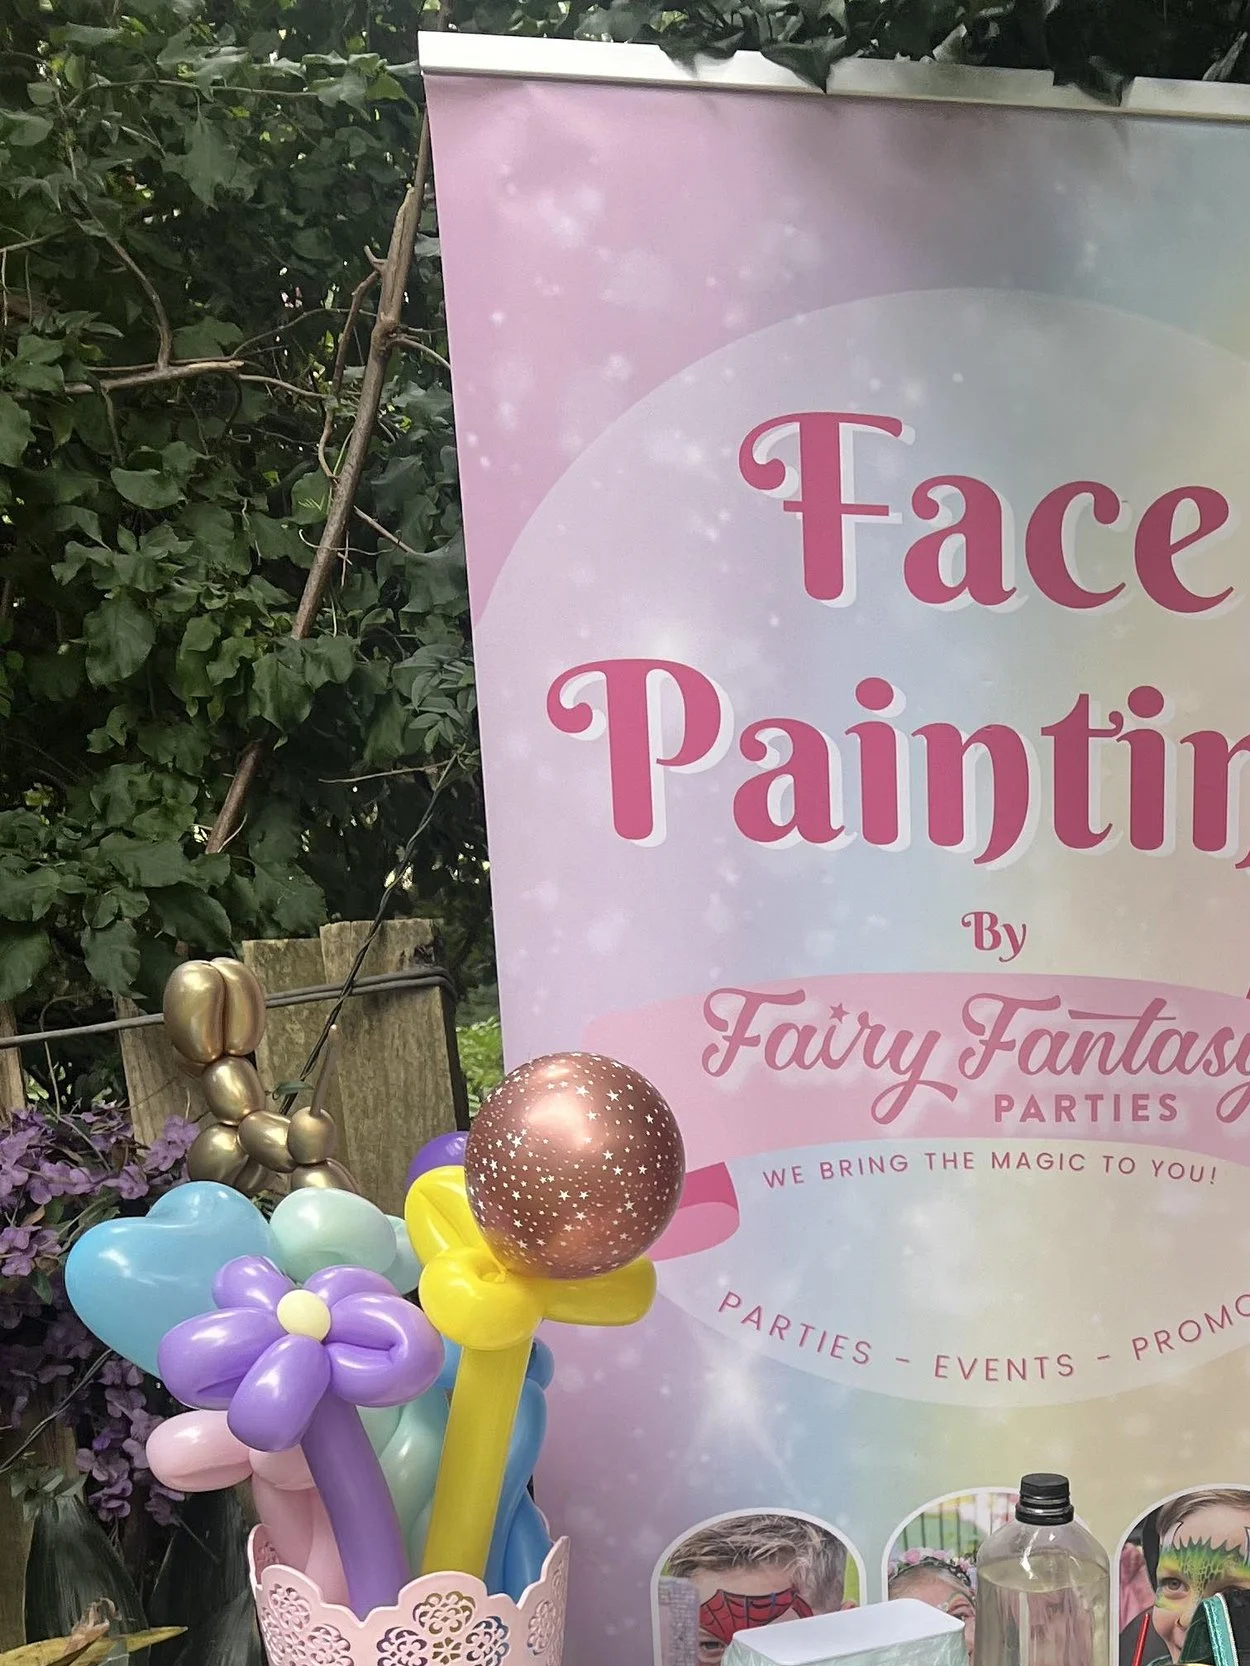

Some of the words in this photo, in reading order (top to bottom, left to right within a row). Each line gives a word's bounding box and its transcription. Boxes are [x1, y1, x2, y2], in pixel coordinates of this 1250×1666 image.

[739, 411, 1236, 616] Face
[961, 911, 1027, 963] By
[701, 987, 958, 1125] Fairy
[994, 1092, 1179, 1123] PARTIES
[762, 1165, 805, 1189] WE
[819, 1153, 909, 1181] BRING
[923, 1151, 975, 1171] THE
[991, 1151, 1087, 1172] MAGIC
[1101, 1154, 1136, 1175] TO
[1151, 1159, 1217, 1184] YOU!
[717, 1290, 872, 1366] PARTIES
[934, 1353, 1075, 1382] EVENTS
